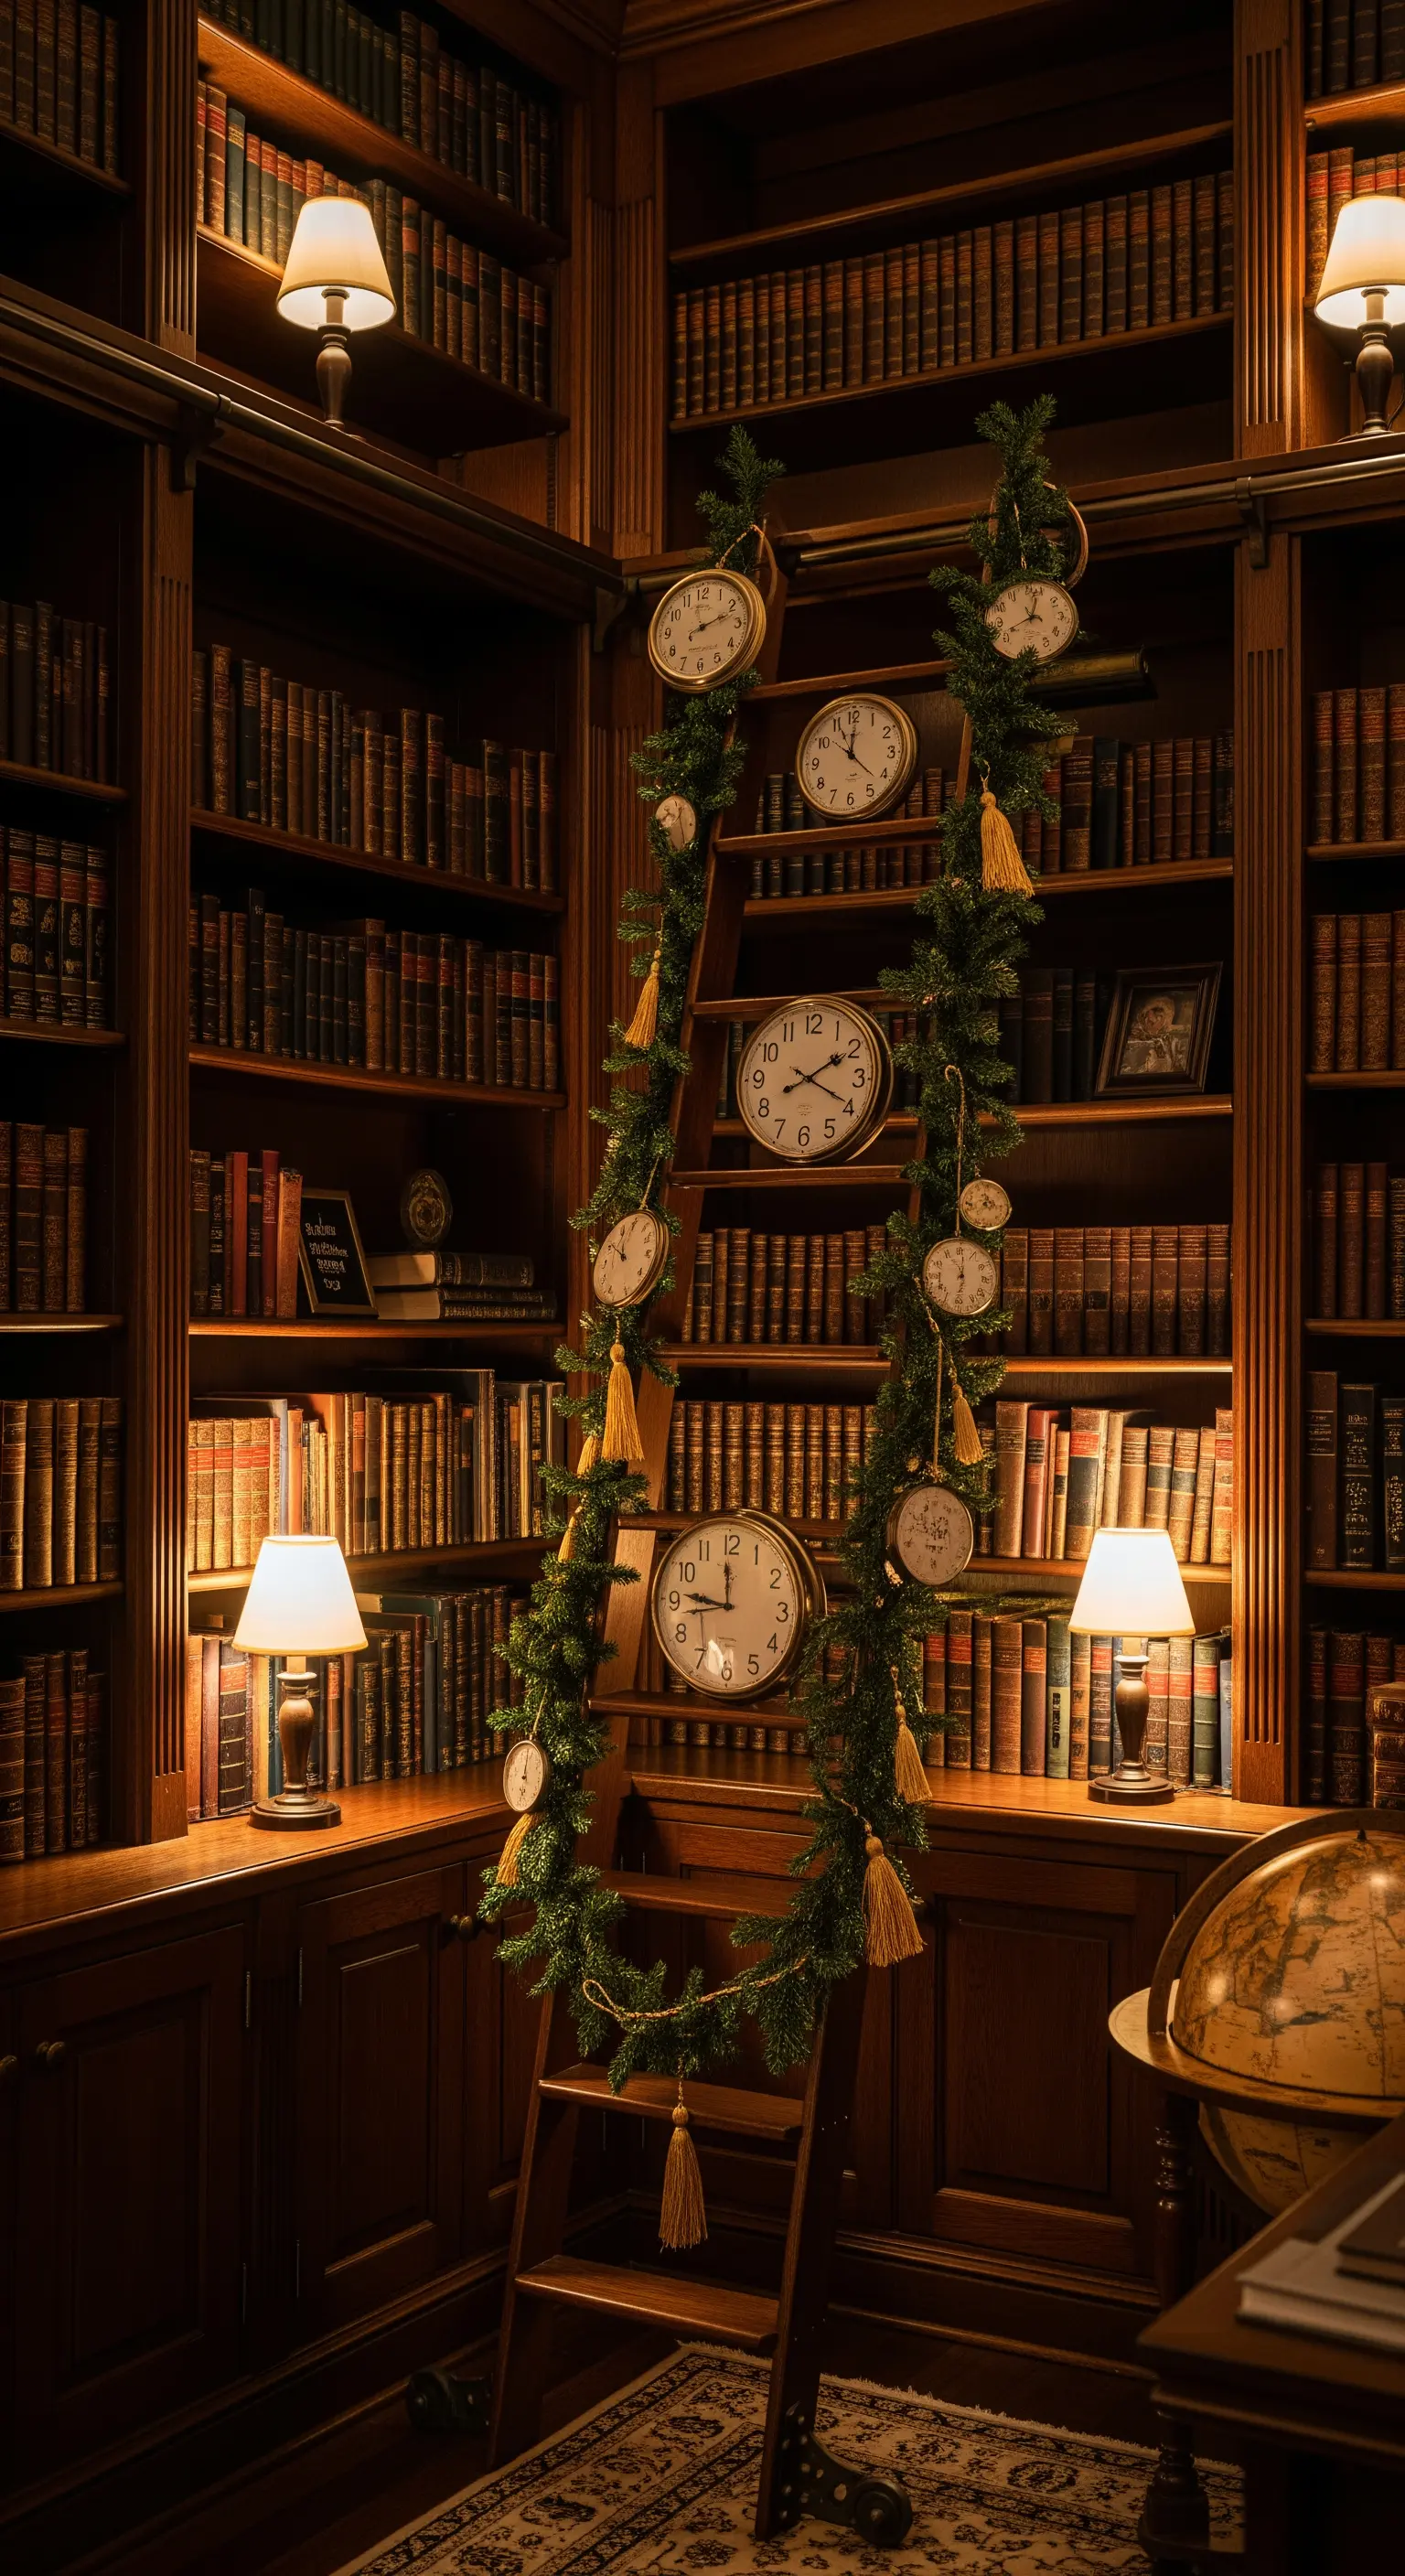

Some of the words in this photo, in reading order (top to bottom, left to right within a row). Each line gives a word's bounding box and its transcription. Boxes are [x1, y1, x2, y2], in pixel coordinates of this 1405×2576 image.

[683, 595, 691, 607] 11
[697, 587, 710, 601] 12
[719, 589, 723, 601] 1
[671, 608, 681, 622] 10
[728, 599, 736, 612] 2
[734, 617, 742, 628] 3
[664, 628, 671, 639] 9
[727, 637, 735, 648] 4
[680, 656, 688, 671] 7
[713, 652, 722, 664] 5
[848, 710, 860, 724] 12
[871, 713, 874, 726] 1
[883, 725, 891, 739] 2
[818, 736, 830, 749] 10
[887, 746, 896, 758] 3
[811, 757, 820, 771] 9
[880, 767, 888, 779] 4
[817, 778, 825, 789] 8
[866, 784, 874, 798] 5
[830, 789, 837, 805] 7
[847, 792, 854, 806] 6
[783, 1022, 794, 1042] 11
[806, 1014, 822, 1035] 12
[835, 1020, 840, 1041] 1
[763, 1043, 778, 1062] 10
[848, 1038, 861, 1058] 2
[753, 1069, 765, 1089] 9
[852, 1068, 865, 1088] 3
[758, 1098, 769, 1118] 8
[842, 1098, 854, 1117] 4
[774, 1119, 786, 1139] 7
[798, 1125, 810, 1146] 6
[823, 1119, 836, 1139] 5
[699, 1540, 710, 1562] 11
[724, 1534, 740, 1555] 12
[755, 1544, 758, 1565] 1
[679, 1562, 695, 1583] 10
[769, 1569, 781, 1589] 2
[670, 1591, 681, 1611] 9
[776, 1602, 789, 1623] 3
[675, 1623, 686, 1643] 8
[767, 1633, 778, 1654] 4
[694, 1648, 707, 1669] 7
[747, 1654, 759, 1675] 5
[721, 1660, 732, 1681] 6
